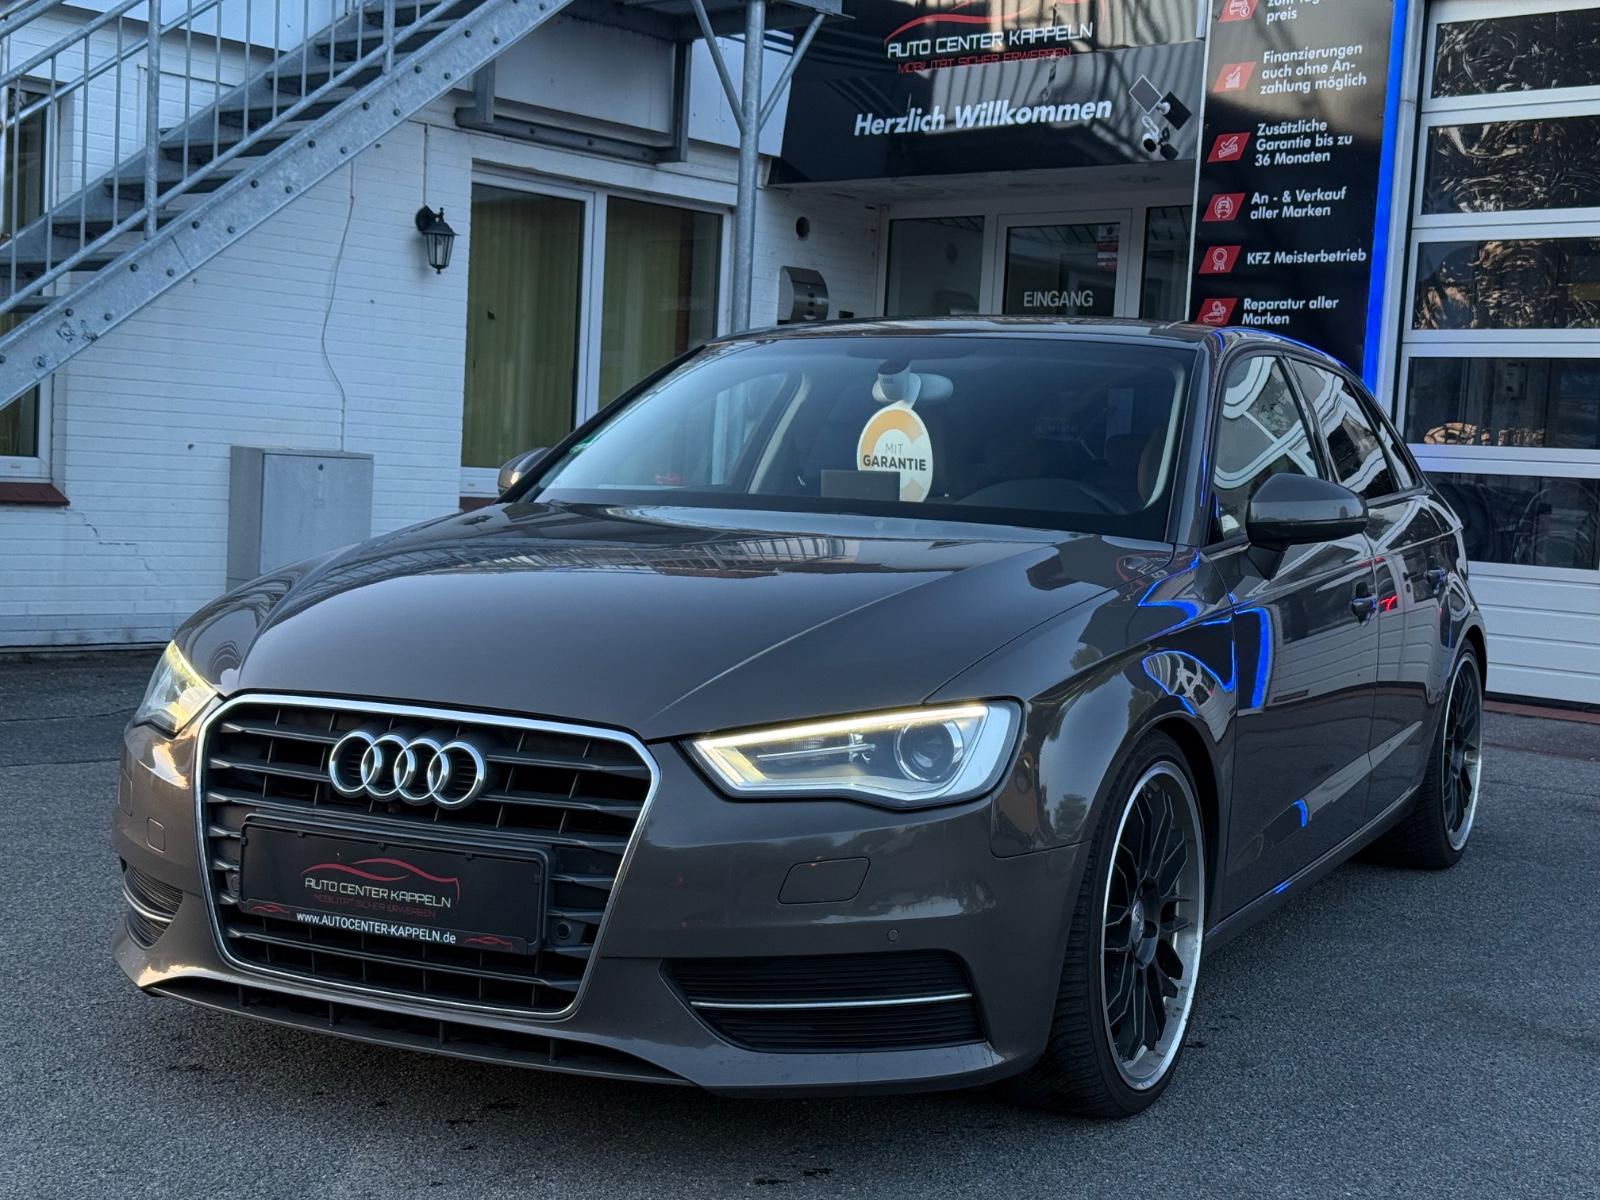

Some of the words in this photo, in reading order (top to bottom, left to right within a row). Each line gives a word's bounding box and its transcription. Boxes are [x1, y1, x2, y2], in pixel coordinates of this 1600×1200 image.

[1266, 6, 1297, 25] preis
[888, 39, 931, 58] AUTO
[935, 31, 1004, 53] CENTER
[1009, 22, 1094, 46] KAPPELN
[1263, 44, 1363, 64] Finanzierungen
[1261, 65, 1292, 79] auch
[1296, 61, 1328, 76] ohne
[1331, 60, 1356, 72] An-
[1260, 77, 1311, 95] zahlung
[1315, 73, 1367, 91] möglich
[854, 107, 945, 136] Herzlich
[954, 99, 1113, 129] Willkommen
[1257, 118, 1328, 136] Zusätzliche
[1256, 134, 1311, 151] Garantie
[1315, 133, 1334, 147] bis
[1337, 135, 1353, 145] zu
[1255, 153, 1271, 166] 36
[1274, 151, 1331, 165] Monaten
[1250, 192, 1269, 205] An
[1282, 190, 1292, 203] &
[1296, 186, 1348, 202] Verkauf
[1250, 206, 1279, 220] aller
[1282, 204, 1331, 218] Marken
[1246, 252, 1271, 265] KFZ
[1274, 248, 1367, 264] Meisterbetrieb
[1023, 290, 1094, 307] EINGANG
[1243, 297, 1306, 313] Reparatur
[1309, 295, 1339, 309] aller
[1241, 313, 1290, 325] Marken
[885, 443, 904, 454] MIT
[863, 454, 927, 471] GARANTIE
[305, 877, 338, 892] AUTO
[339, 882, 389, 899] CENTER
[391, 890, 452, 908] KAPPELN
[296, 911, 457, 944] www.AUTOCENTER-KAPPELN.de
